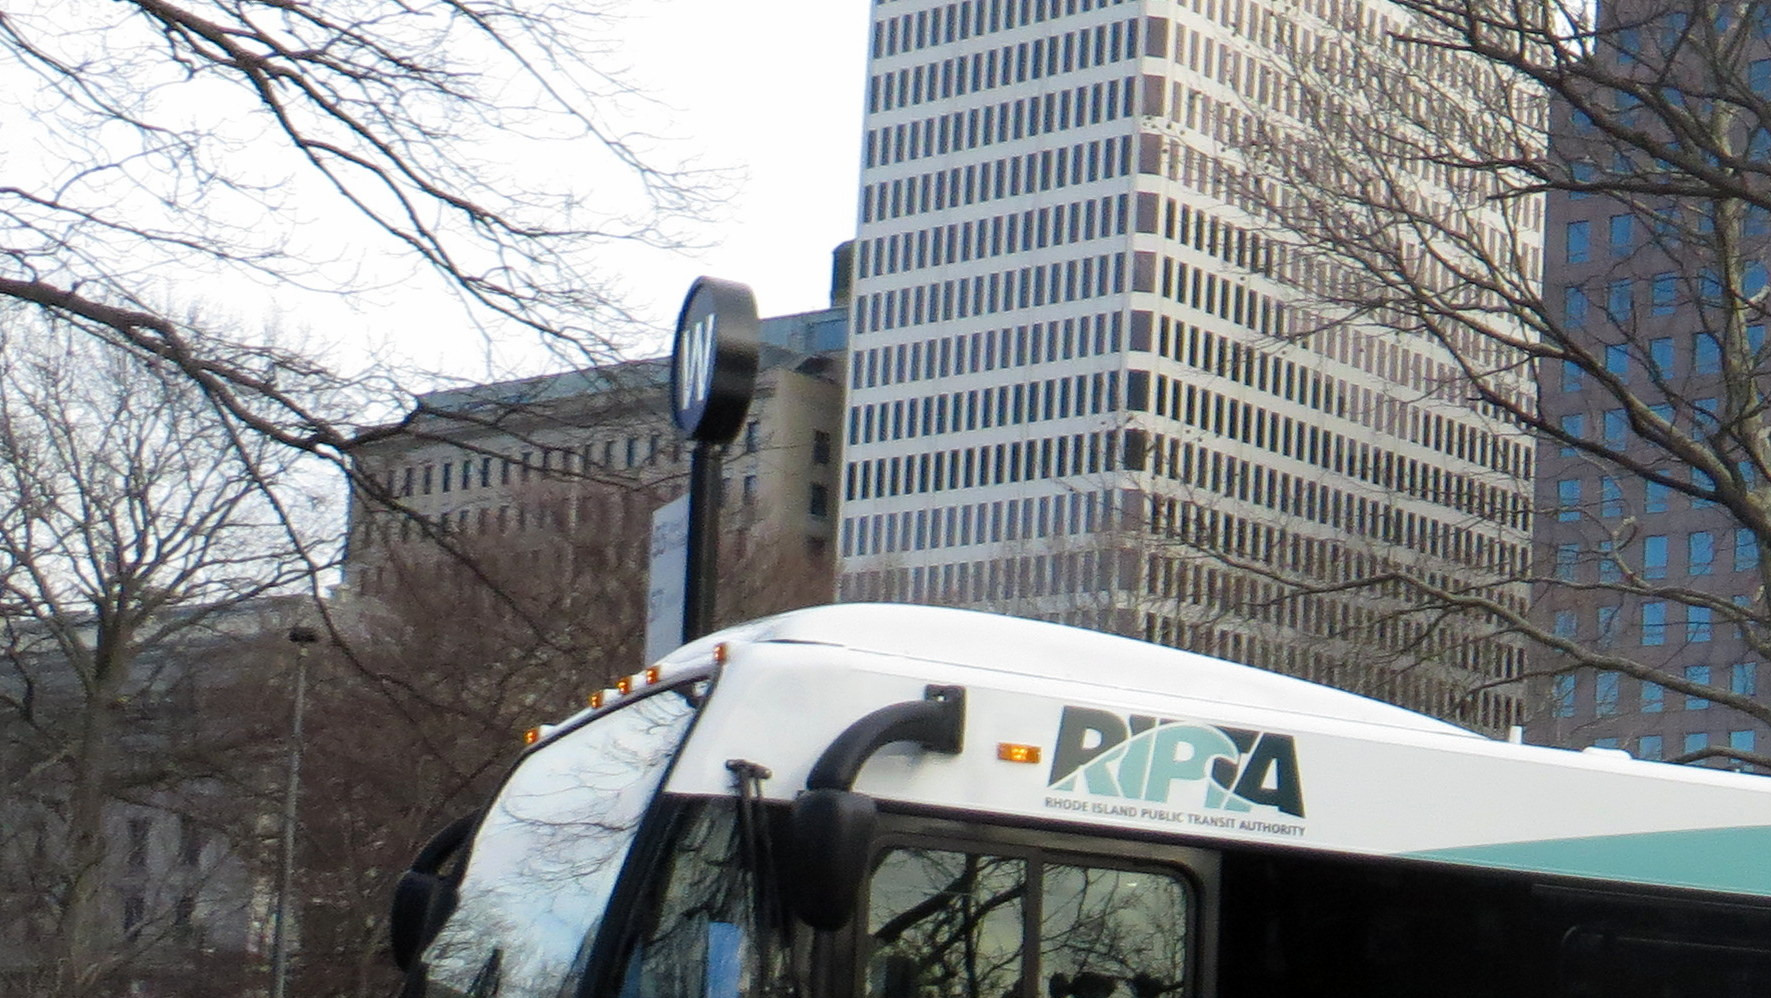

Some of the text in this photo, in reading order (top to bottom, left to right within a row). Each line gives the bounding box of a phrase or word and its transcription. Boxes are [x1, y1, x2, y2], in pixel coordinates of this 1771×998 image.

[681, 312, 716, 411] W
[1047, 704, 1307, 819] RIPTA
[1044, 796, 1307, 838] RHODE ISLAND PUBLIC TRANSIT AUTHORITY
